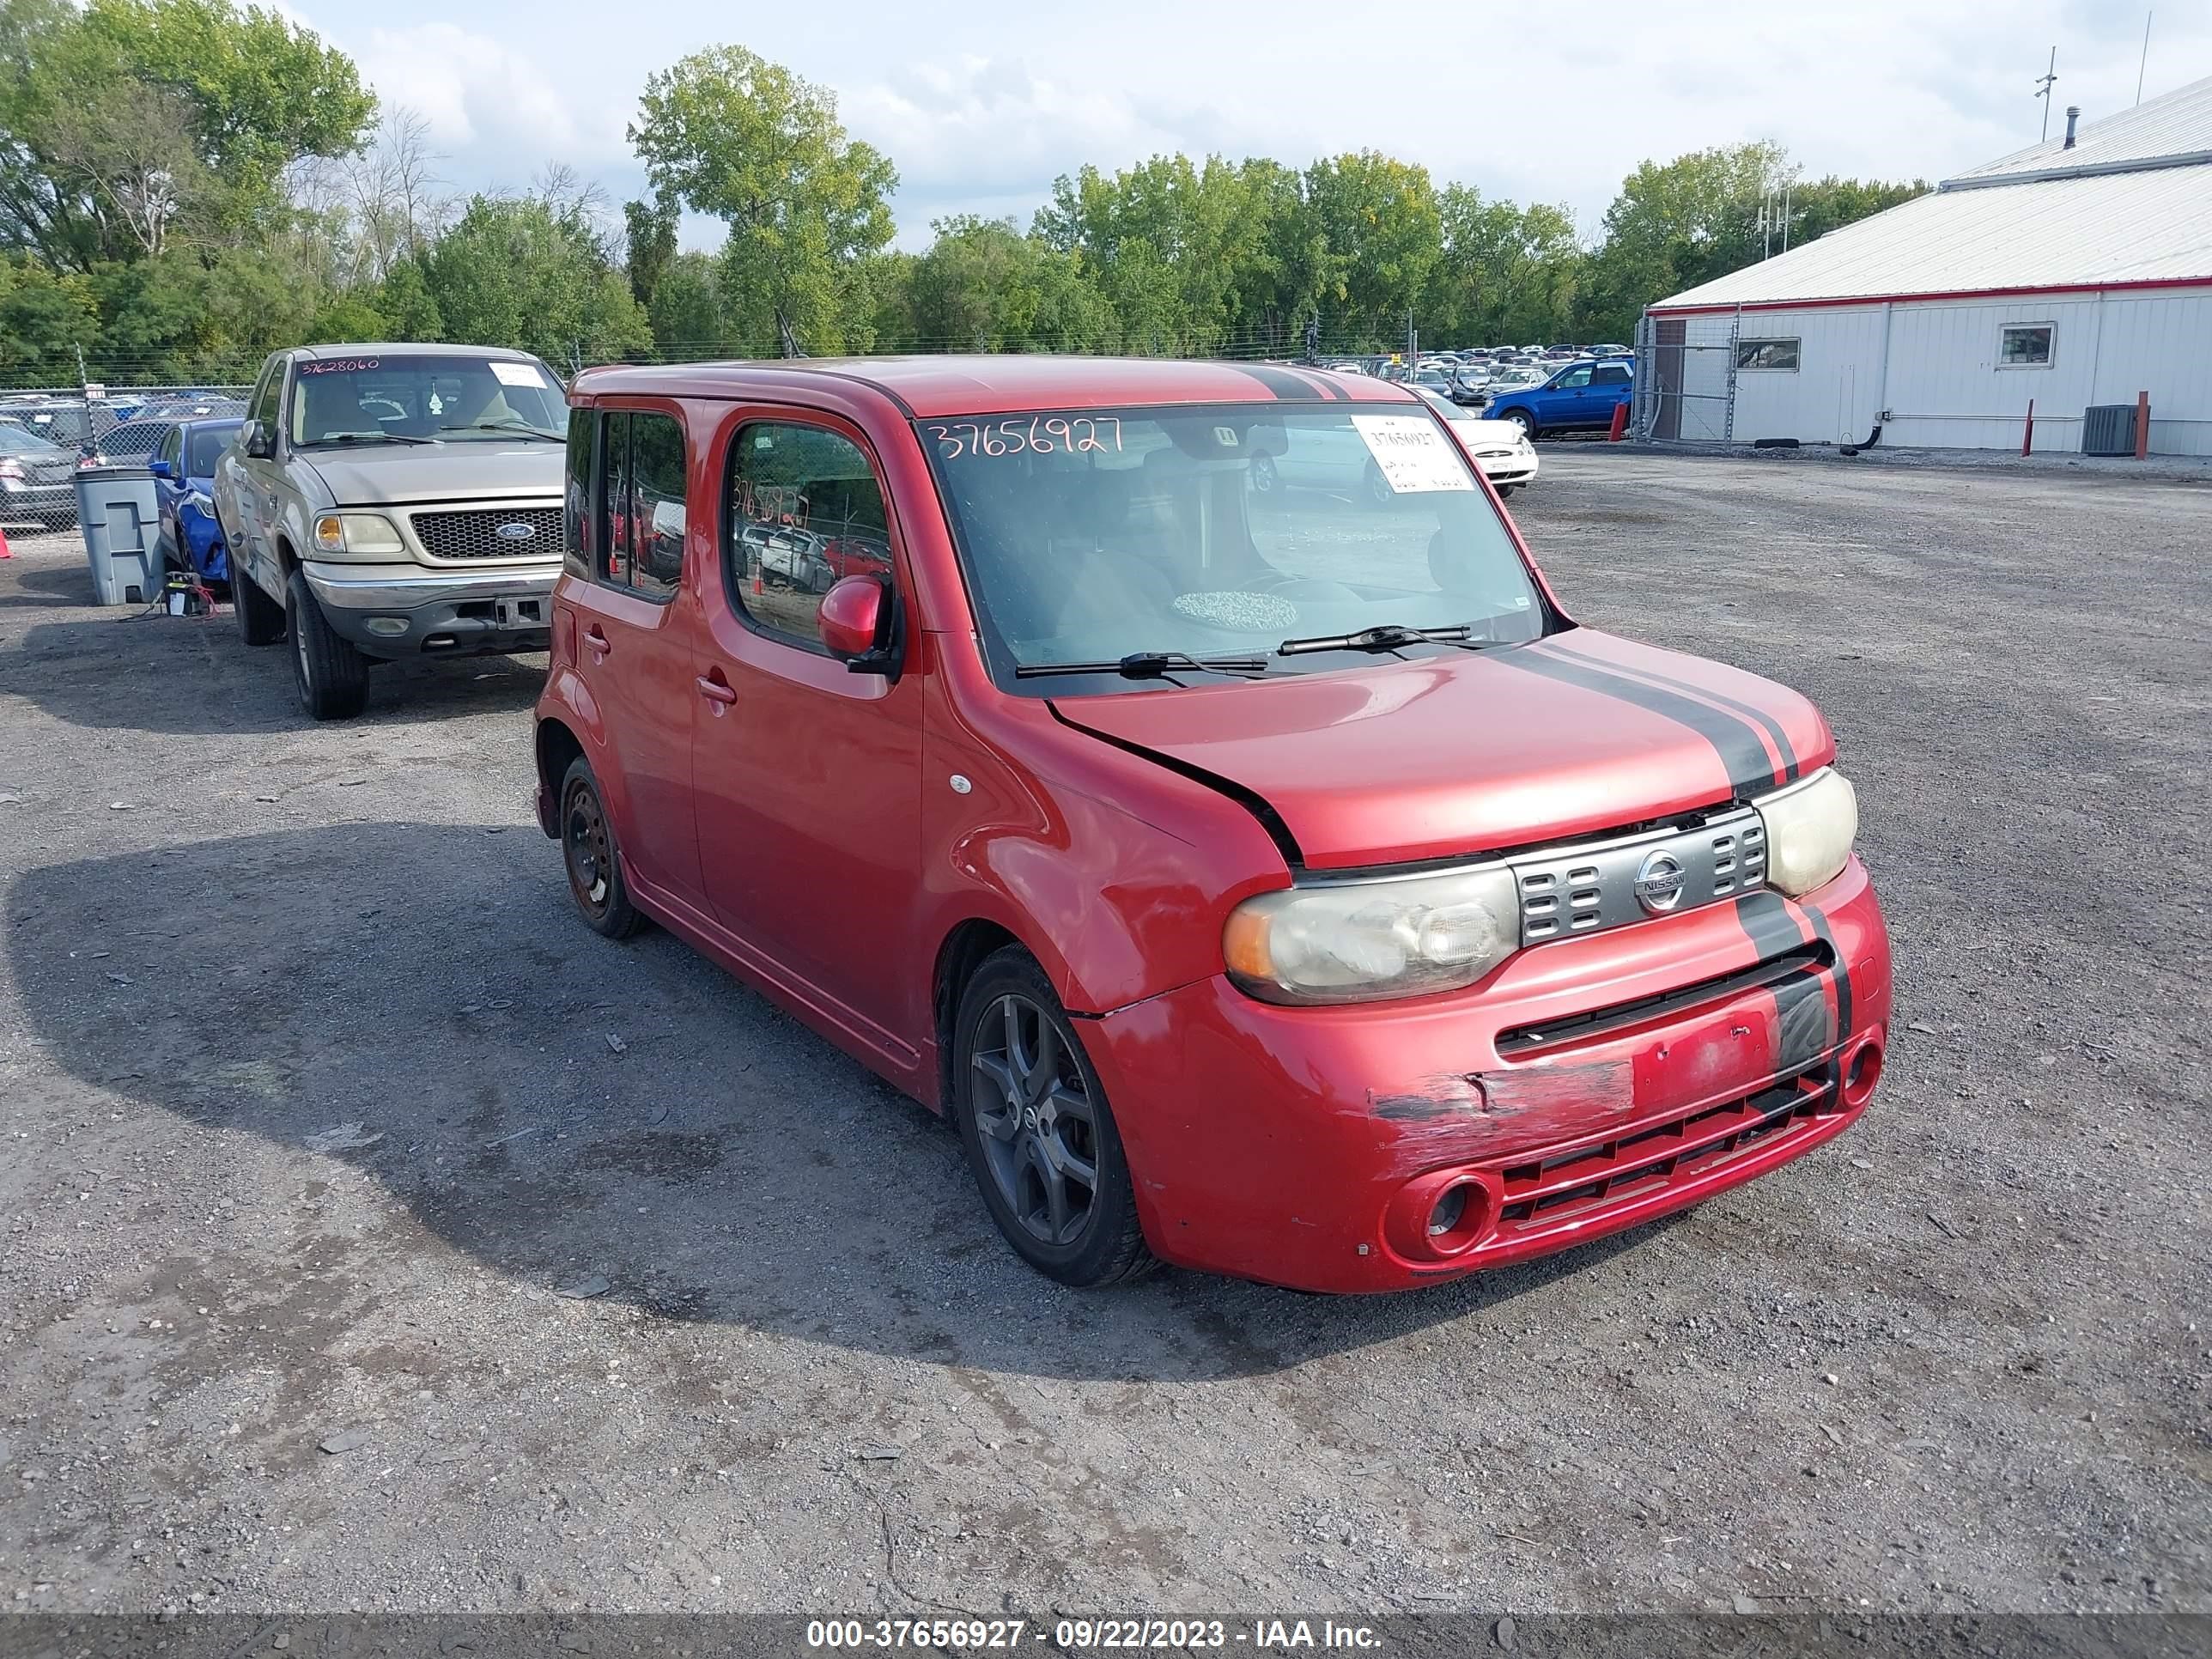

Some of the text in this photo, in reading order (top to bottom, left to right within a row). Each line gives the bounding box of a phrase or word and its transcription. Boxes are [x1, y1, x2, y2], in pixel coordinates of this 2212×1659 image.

[301, 360, 379, 374] 37628060
[927, 416, 1122, 459] 37656927
[1644, 873, 1685, 891] NISSAN
